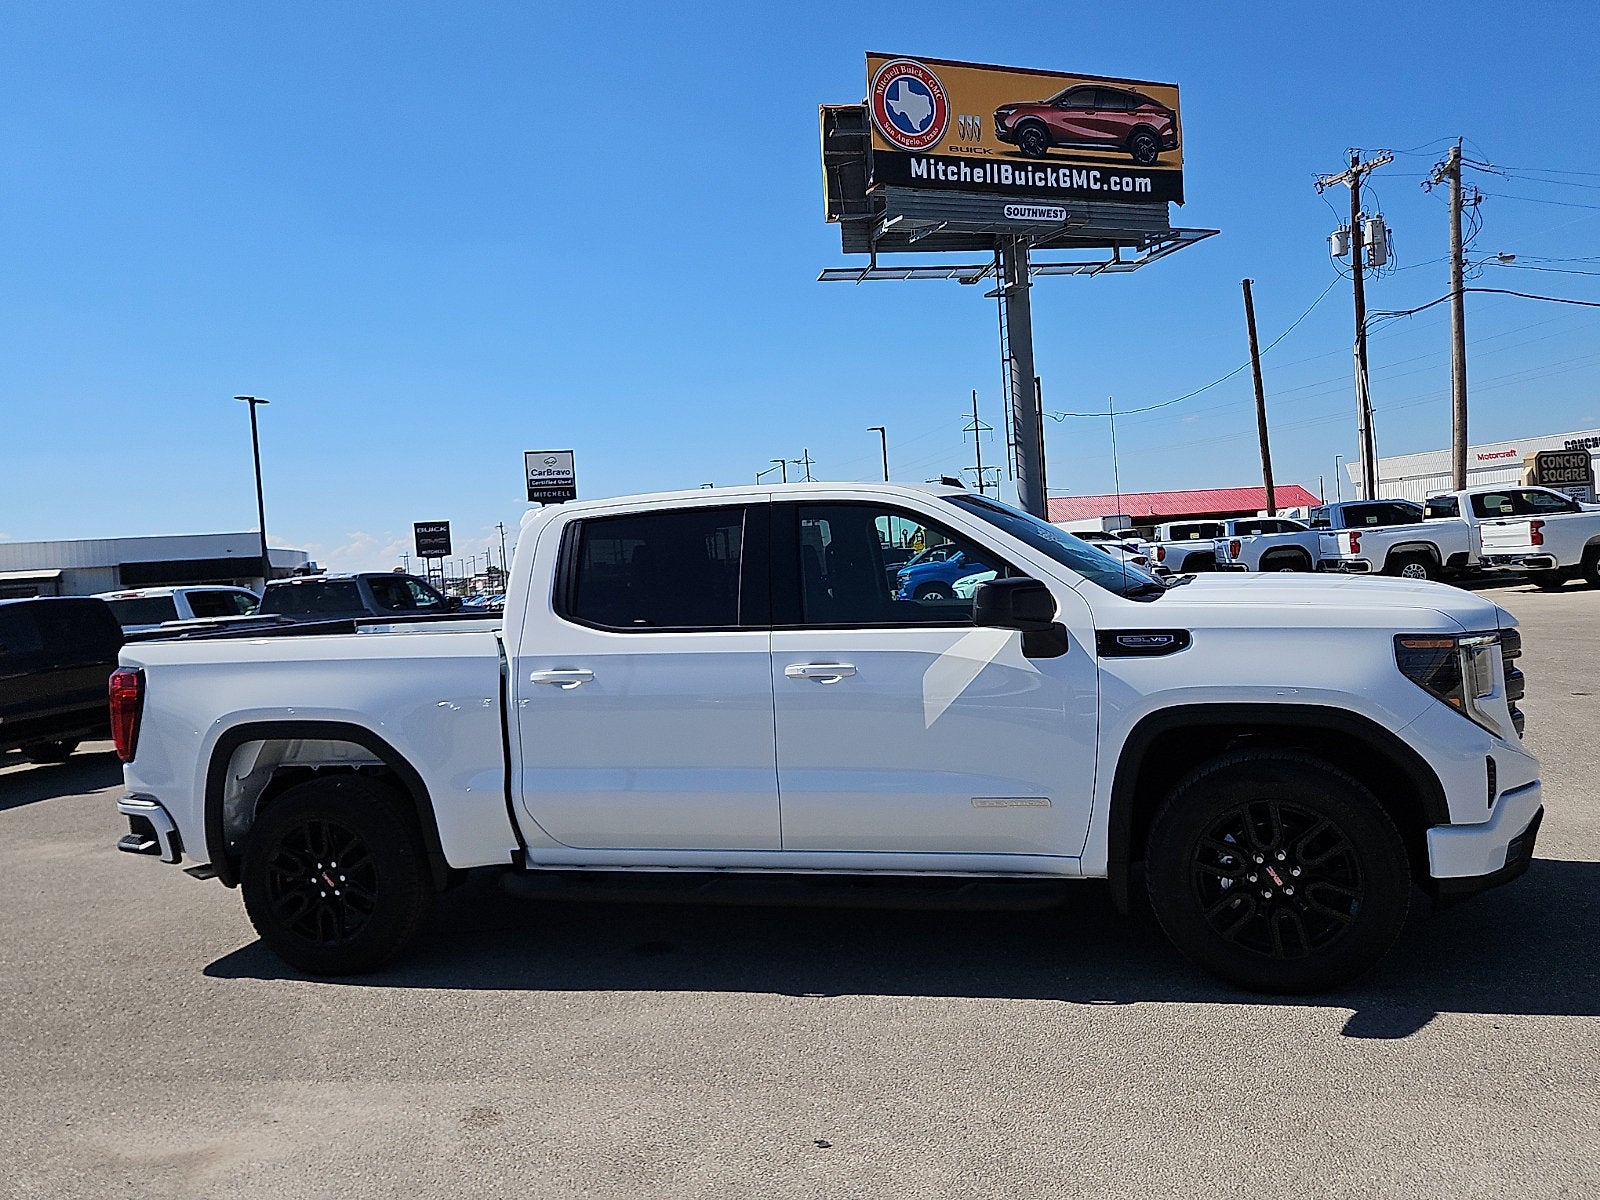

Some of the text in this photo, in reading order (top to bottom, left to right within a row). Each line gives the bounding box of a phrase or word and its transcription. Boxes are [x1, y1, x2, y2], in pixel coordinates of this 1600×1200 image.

[875, 66, 900, 95] Mitchell
[900, 65, 923, 78] Buick
[927, 79, 943, 100] GMC
[883, 121, 939, 146] San Angelo, Texas
[948, 145, 993, 155] BUICK
[910, 158, 1151, 192] MitchellBuickGMC.com
[1006, 206, 1065, 219] SOUTHWEST
[1476, 449, 1517, 461] Motorcraft
[1540, 454, 1586, 468] CONCHO
[531, 468, 571, 476] CarBravo
[1542, 468, 1587, 481] SQUARE
[533, 490, 571, 498] MITCHELL
